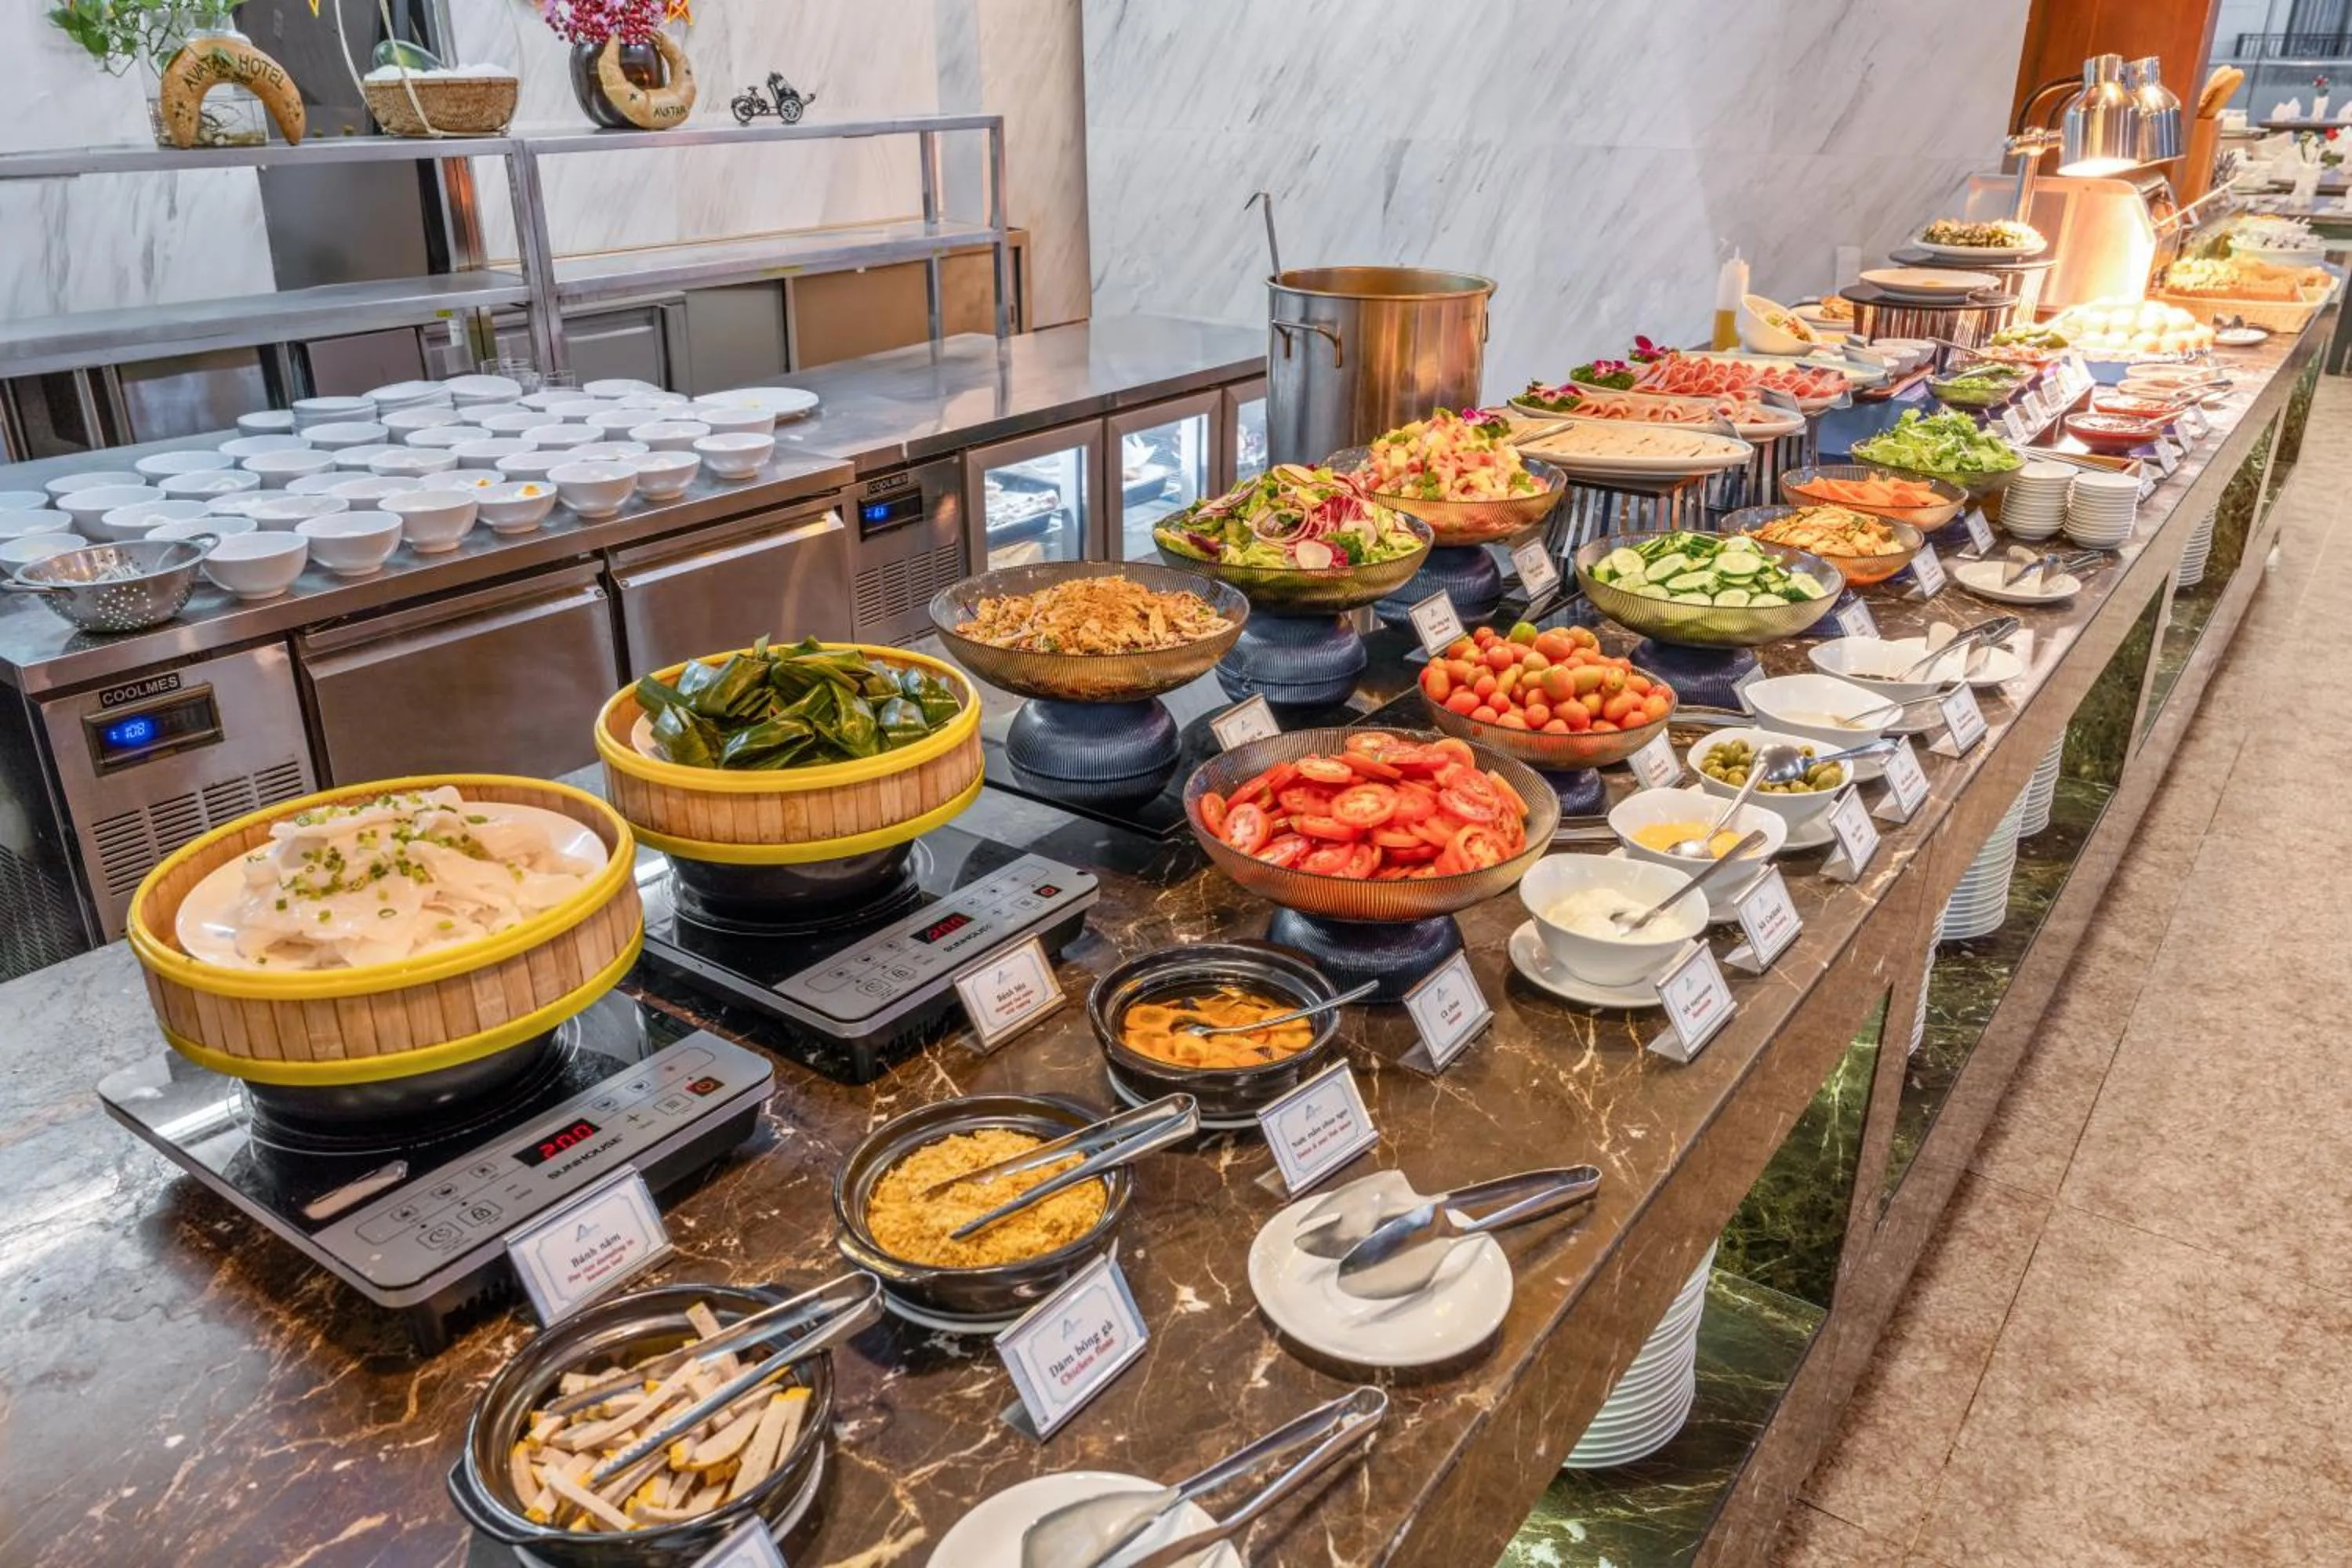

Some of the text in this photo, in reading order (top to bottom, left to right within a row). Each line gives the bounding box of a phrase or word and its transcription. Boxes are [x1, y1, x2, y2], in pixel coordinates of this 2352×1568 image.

[238, 53, 285, 90] HOTEL
[102, 676, 179, 705] COOLMES
[539, 1123, 594, 1160] 200
